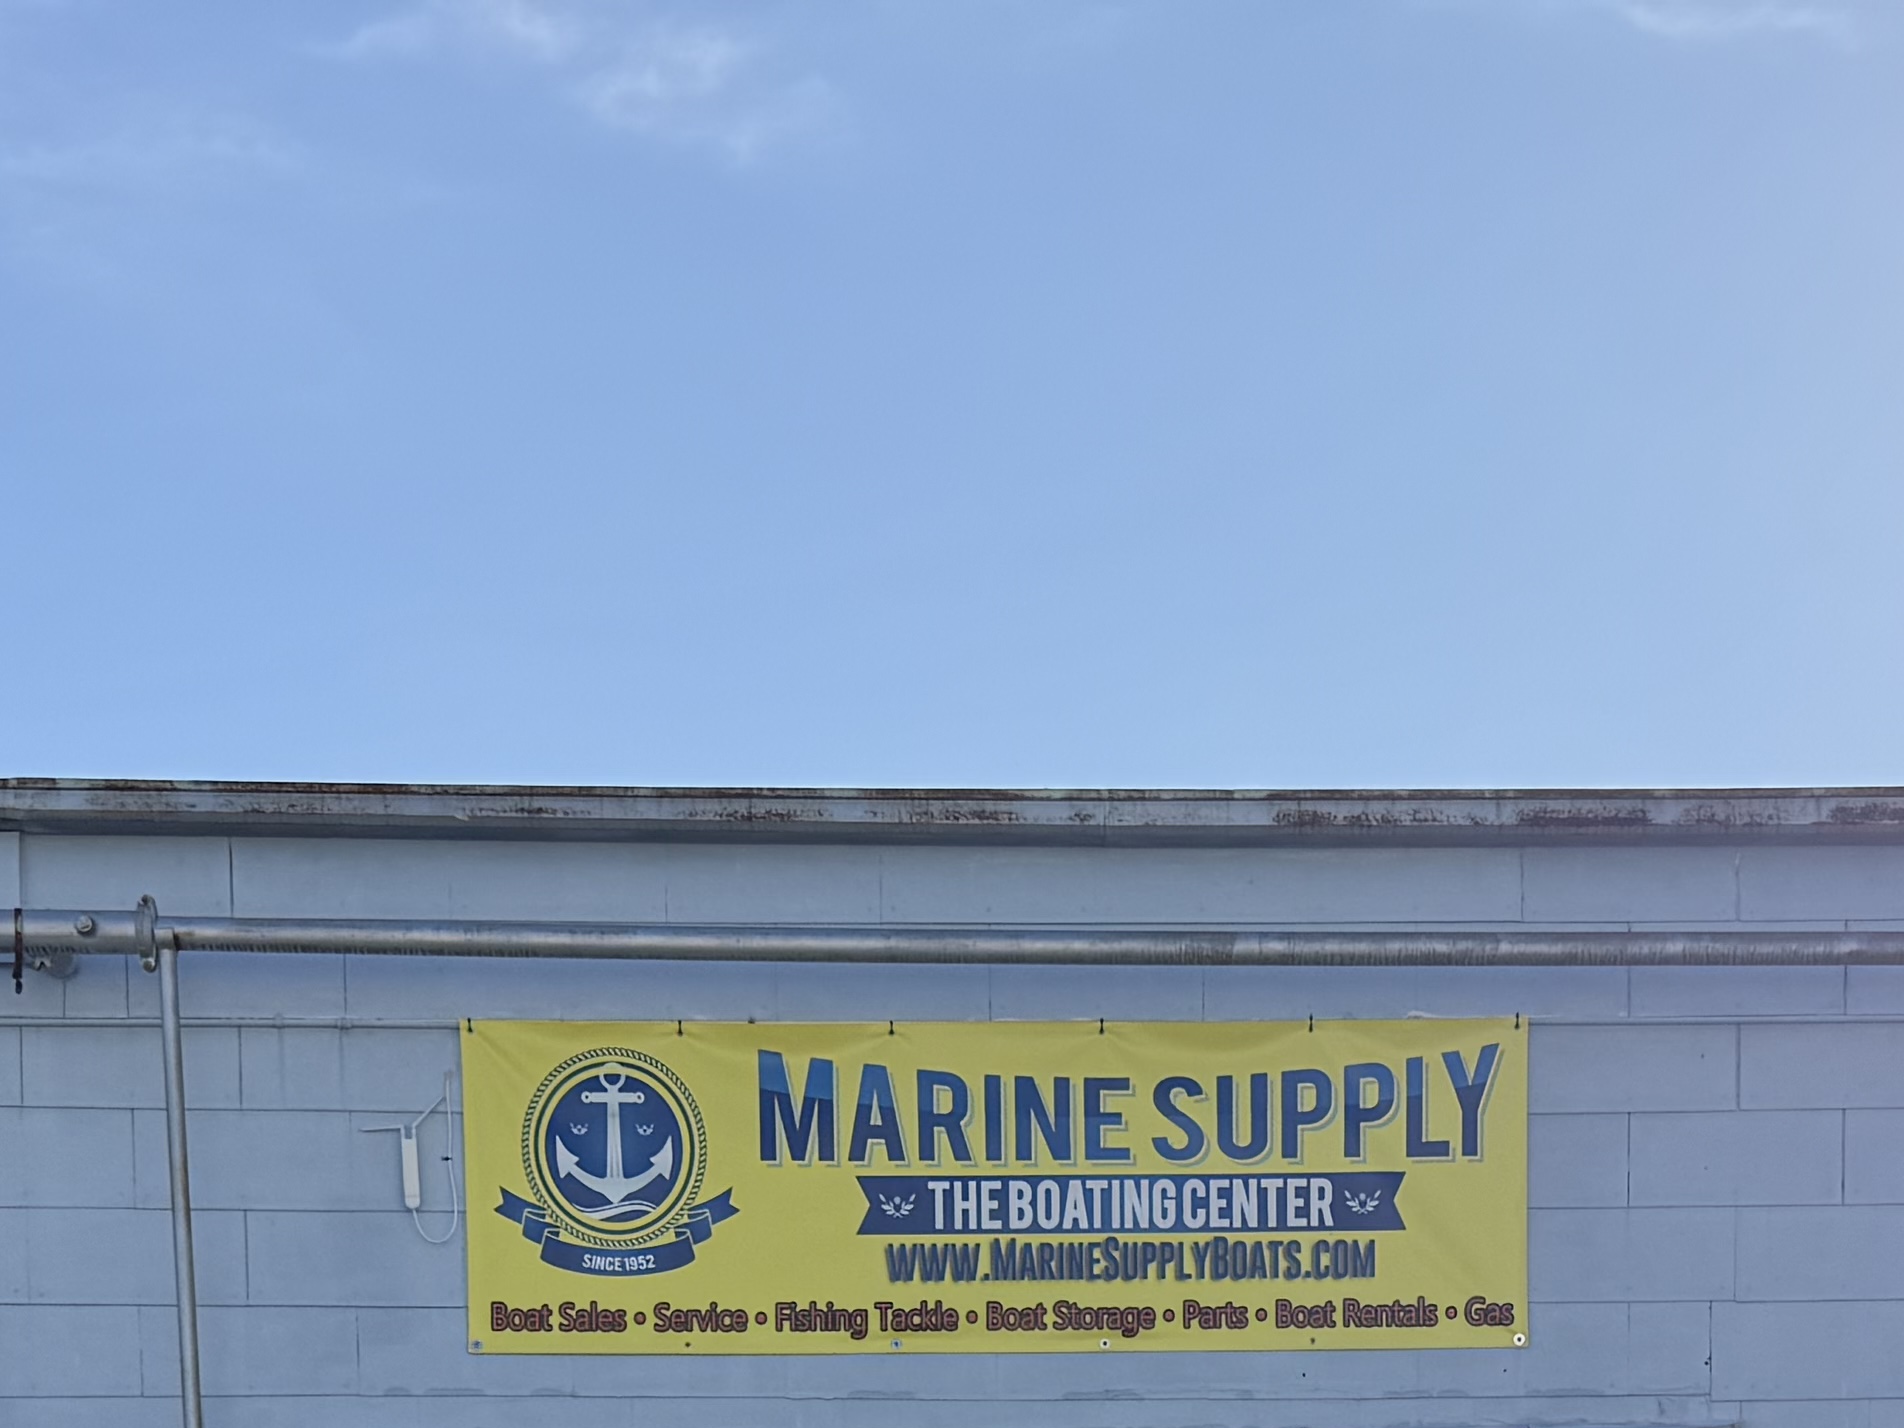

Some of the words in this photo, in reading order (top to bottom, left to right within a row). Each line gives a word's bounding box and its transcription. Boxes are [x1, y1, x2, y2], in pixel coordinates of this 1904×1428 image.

[757, 1049, 1133, 1165] MARINE
[1151, 1043, 1501, 1164] SUPPLY
[927, 1179, 1002, 1230] THE
[1009, 1178, 1177, 1230] BOATING
[1182, 1177, 1334, 1228] CENTER
[582, 1253, 623, 1271] SINCE
[623, 1254, 656, 1272] 1952
[491, 1301, 553, 1332] Boat
[558, 1301, 628, 1333] Sales
[653, 1302, 749, 1333] Service
[774, 1303, 869, 1340] Fishing
[874, 1302, 960, 1333] Tackle
[985, 1301, 1048, 1331] Boat
[1052, 1301, 1157, 1338] Storage
[1182, 1299, 1249, 1330] Parts
[1275, 1298, 1337, 1329] Boat
[1342, 1297, 1438, 1328] Rentals
[1464, 1297, 1514, 1327] Gas
